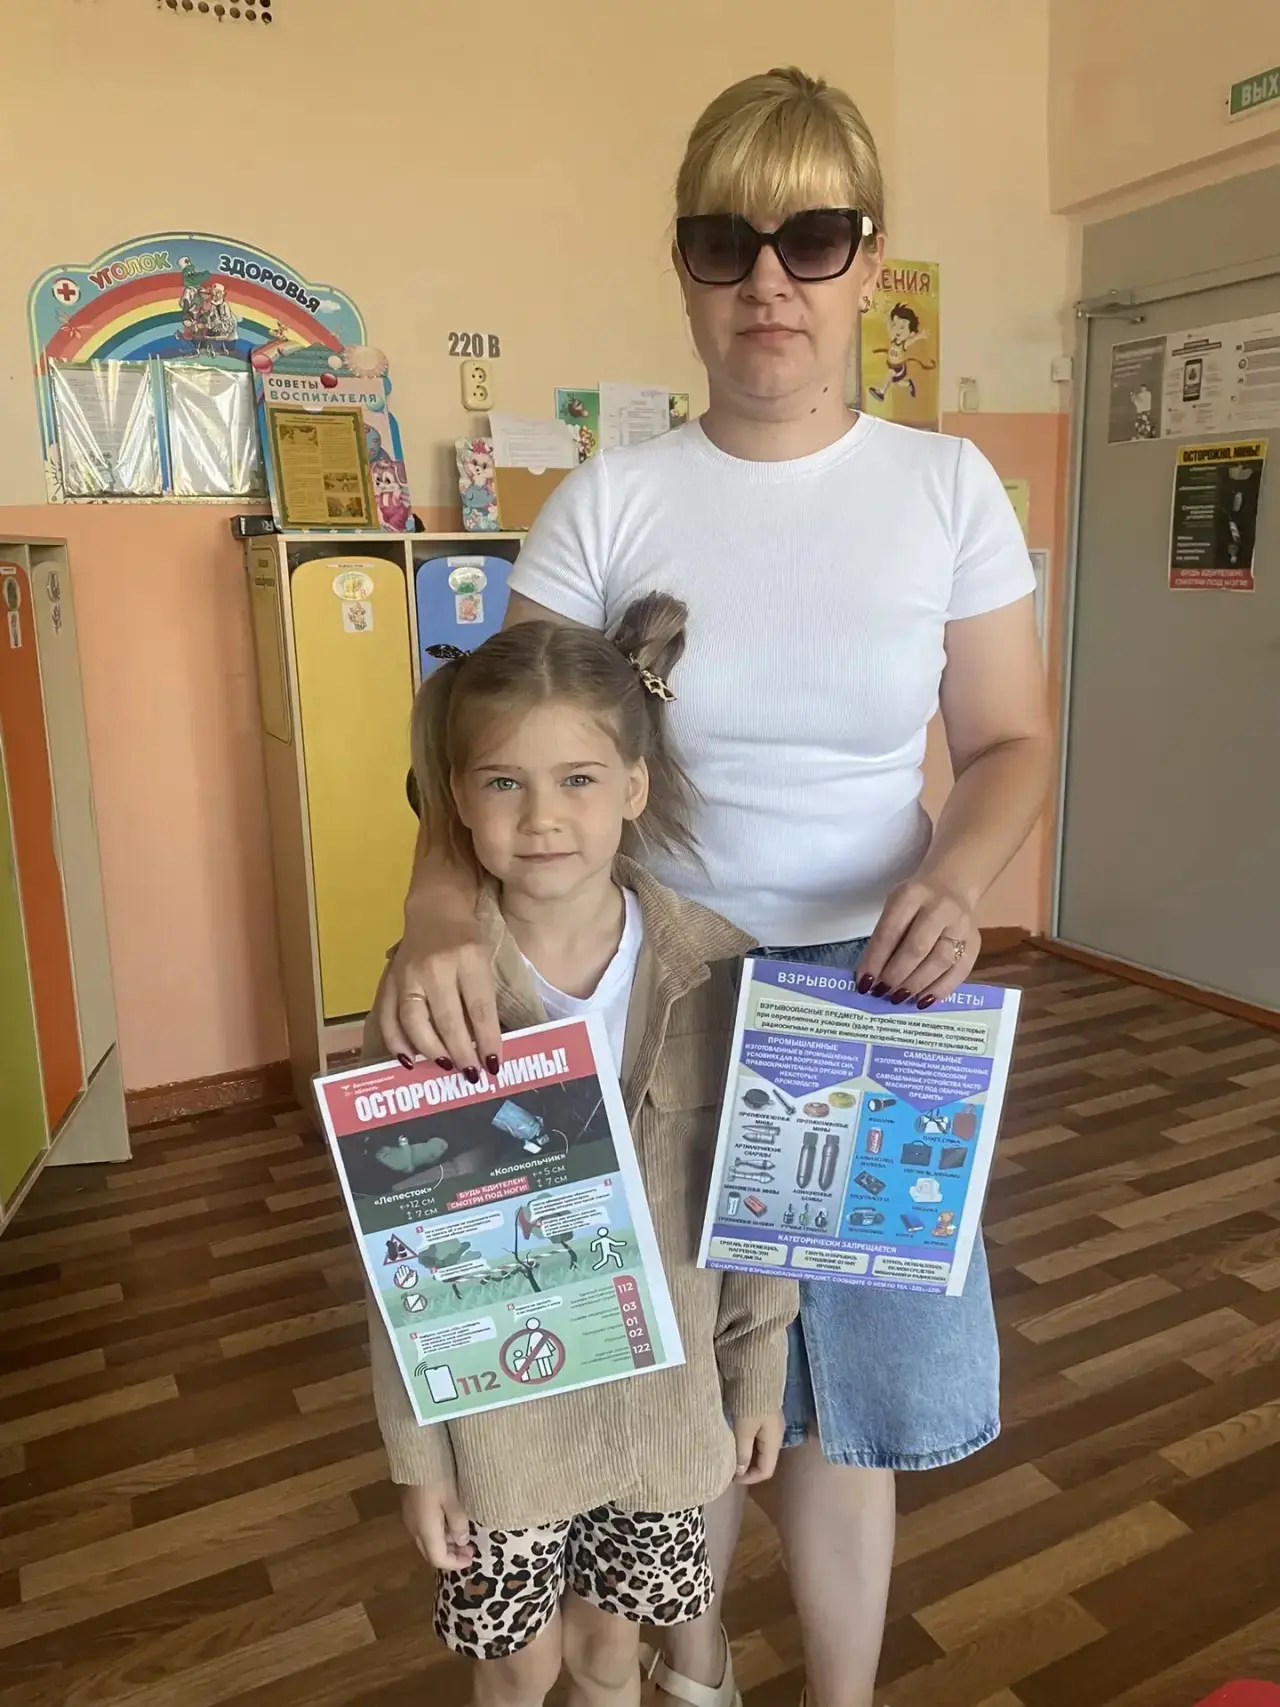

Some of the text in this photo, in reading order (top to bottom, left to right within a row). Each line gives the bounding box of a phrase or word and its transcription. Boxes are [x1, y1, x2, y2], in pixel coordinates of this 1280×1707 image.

[1241, 73, 1280, 106] ВЫХ
[89, 252, 321, 313] УГОЛОК ЗДОРОВЬЯ
[876, 268, 930, 293] ЕНИЯ
[448, 332, 484, 358] 220
[268, 378, 319, 390] СОВЕТЫ
[270, 391, 377, 403] ВОСПИТАТЕЛЯ
[778, 972, 984, 1006] ВЗРЫВООП МЕТЫ
[760, 1002, 824, 1016] ВЗРЫВООПАСНЫЕ
[824, 1010, 864, 1020] ПРЕДМЕТЫ
[768, 1036, 839, 1051] ПРОМЫШЛЕННЫЕ
[904, 1051, 963, 1064] САМОДЕЛЬНЫЕ
[354, 1048, 570, 1122] ОСТОРОЖНО, МИНЫ!
[490, 1154, 566, 1177] «Колокольчик»
[552, 1165, 566, 1173] см
[554, 1175, 568, 1184] см
[374, 1187, 433, 1206] «Лепесток»
[410, 1197, 436, 1209] 12 см
[451, 1196, 484, 1209] СМОТРИ
[485, 1192, 503, 1201] ПОД
[424, 1208, 438, 1216] см
[778, 1234, 897, 1254] КАТЕГОРИЧЕСКИ ЗАПРЕЩАЕТСЯ
[618, 1282, 634, 1294] 112
[622, 1301, 637, 1313] 03
[626, 1317, 639, 1327] 01
[629, 1328, 644, 1338] 02
[632, 1343, 651, 1355] 122
[456, 1371, 502, 1396] 112
